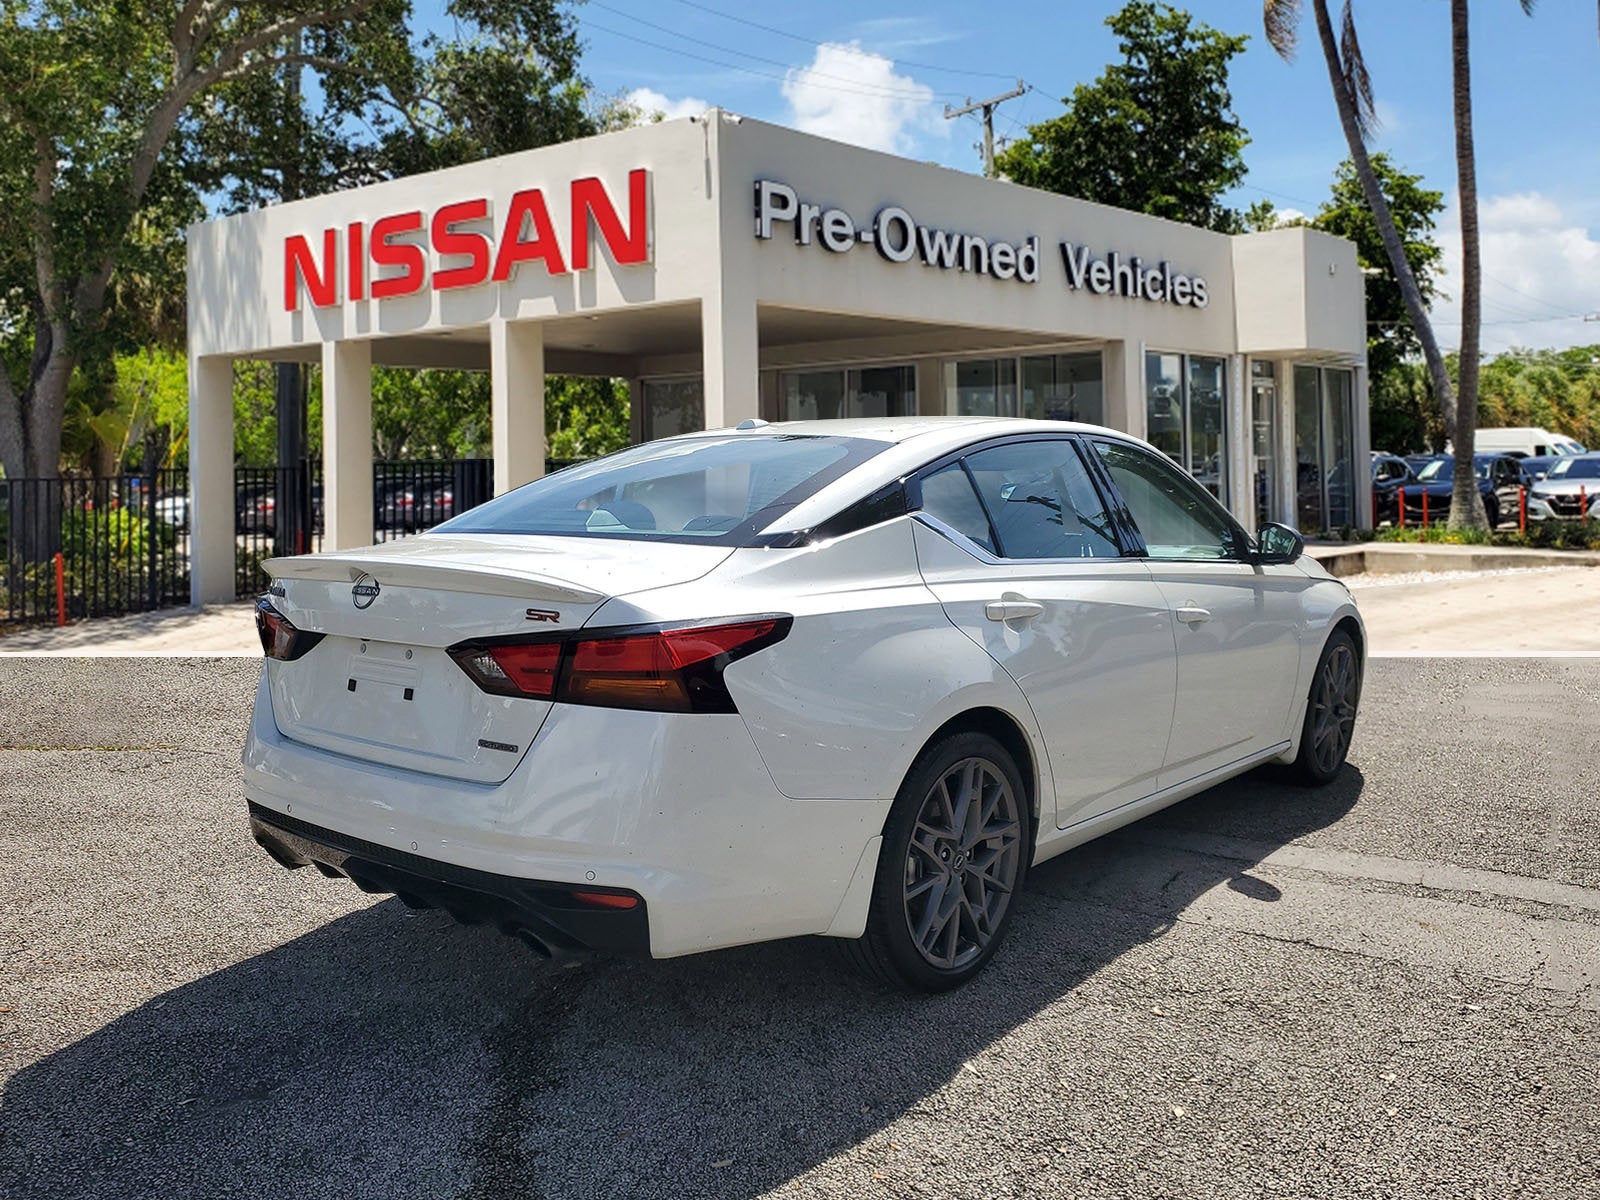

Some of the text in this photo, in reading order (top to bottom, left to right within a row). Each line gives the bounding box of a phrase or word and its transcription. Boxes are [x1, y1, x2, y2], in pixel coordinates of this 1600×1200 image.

[285, 168, 648, 312] NISSAN
[756, 180, 1209, 308] Pre-Owned Vehicles
[352, 585, 379, 597] SSAN
[525, 608, 560, 623] SR
